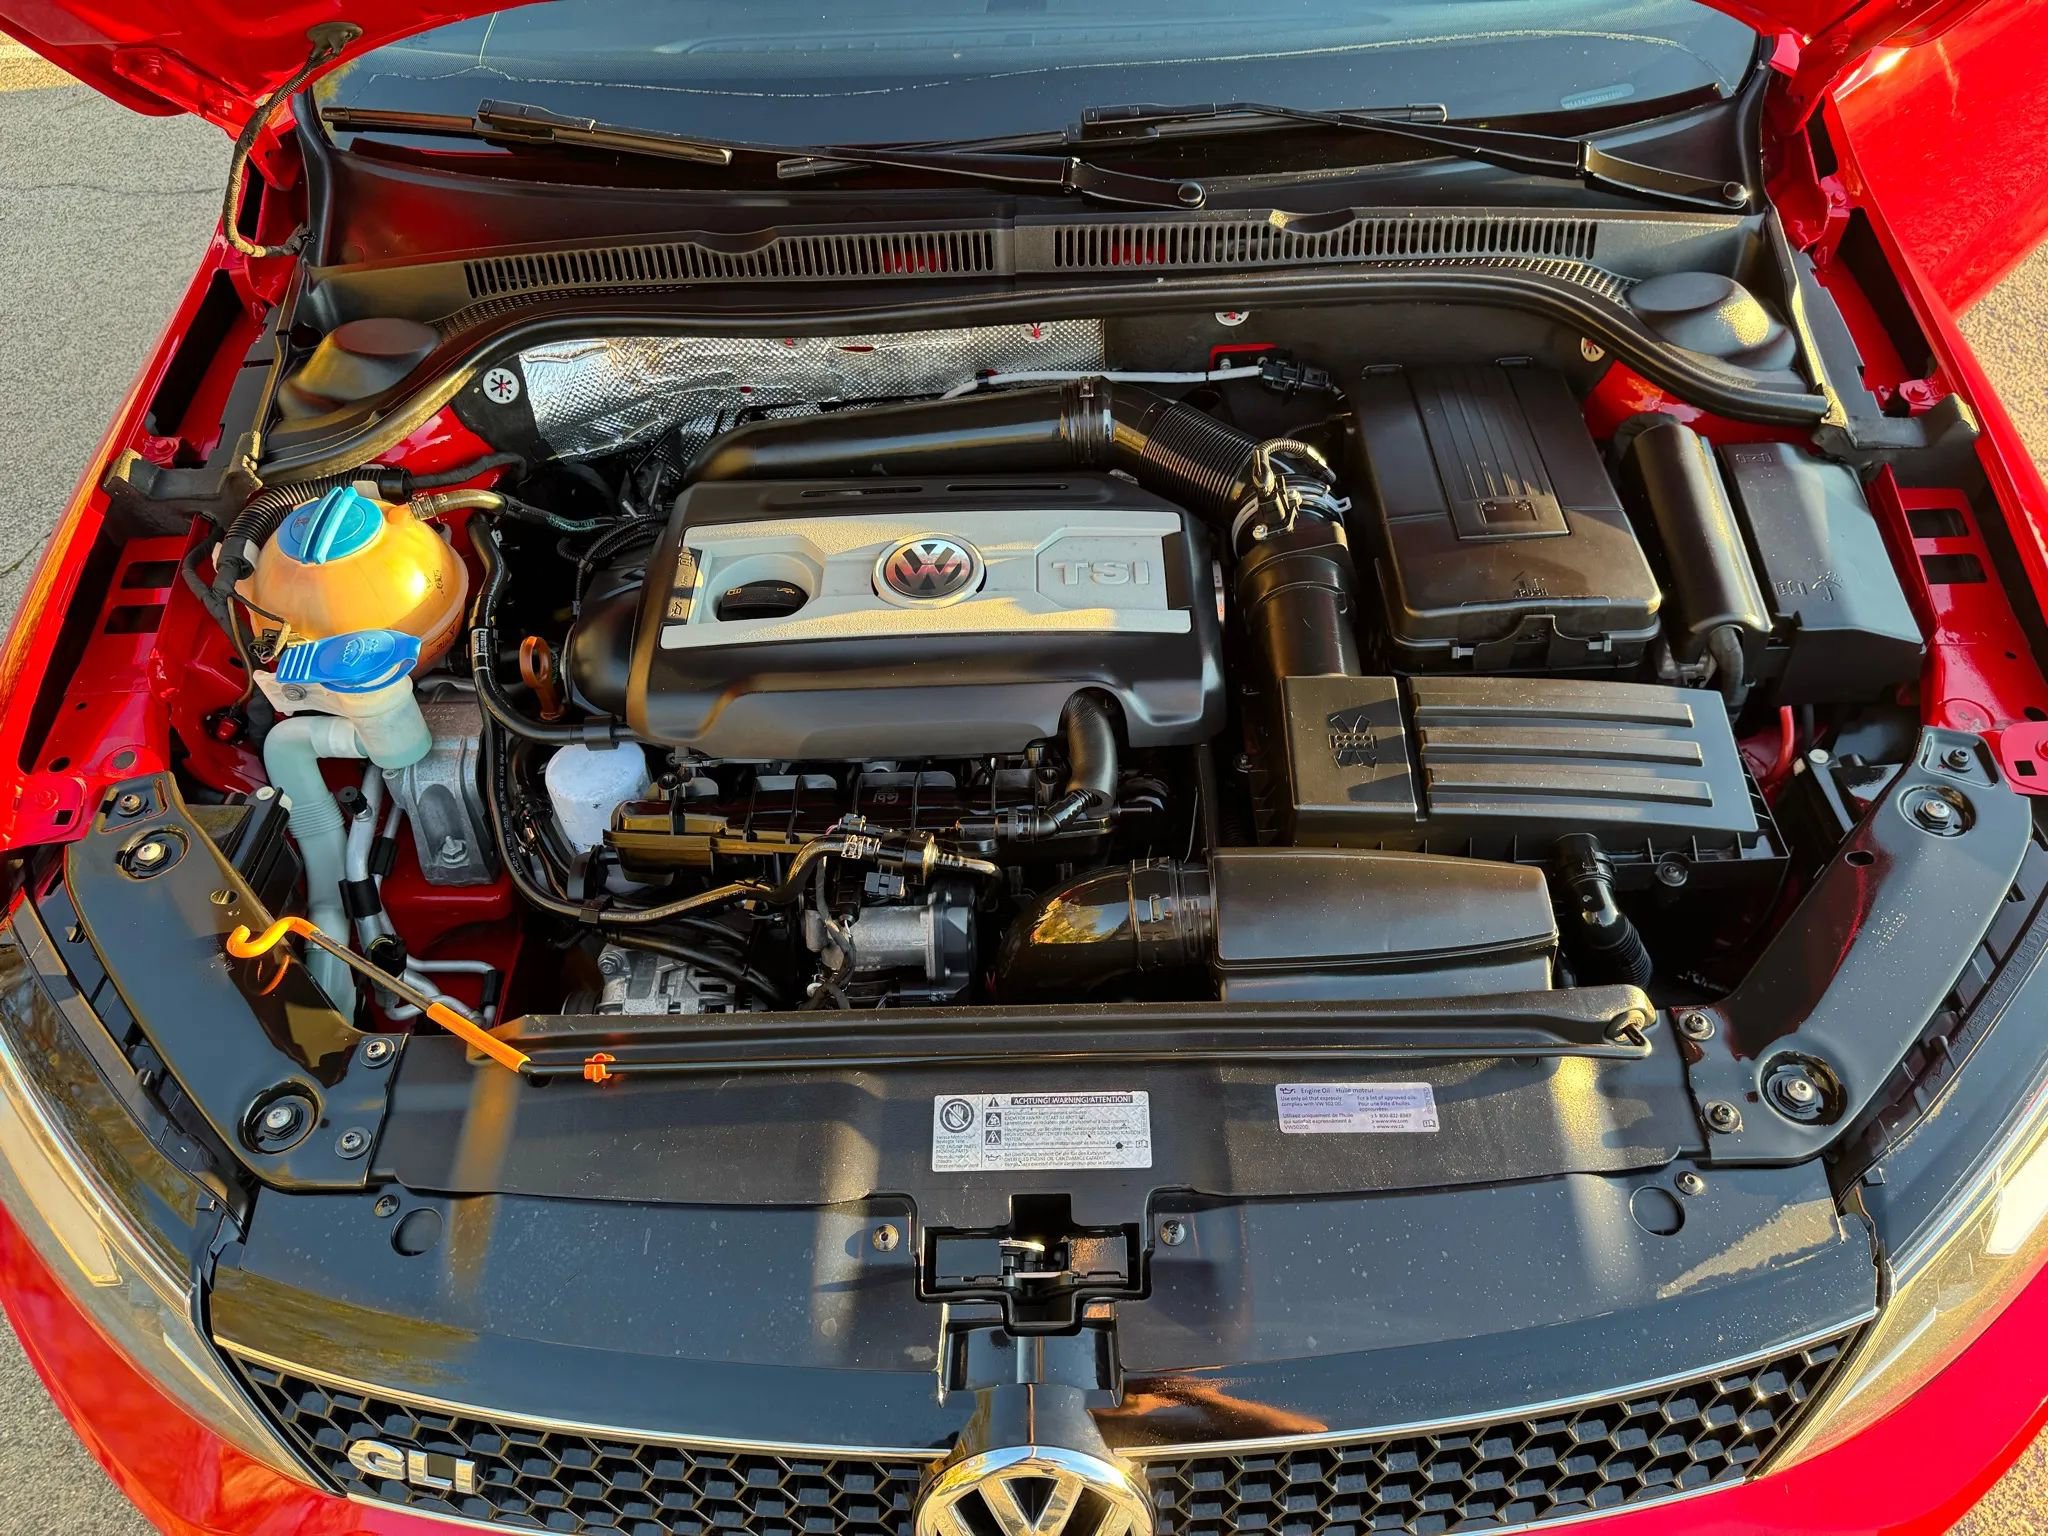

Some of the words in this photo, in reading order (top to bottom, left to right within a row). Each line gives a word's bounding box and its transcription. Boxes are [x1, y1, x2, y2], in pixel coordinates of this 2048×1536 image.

[1051, 560, 1150, 586] TSI
[1518, 587, 1549, 598] PUSH
[347, 1439, 476, 1495] GLI
